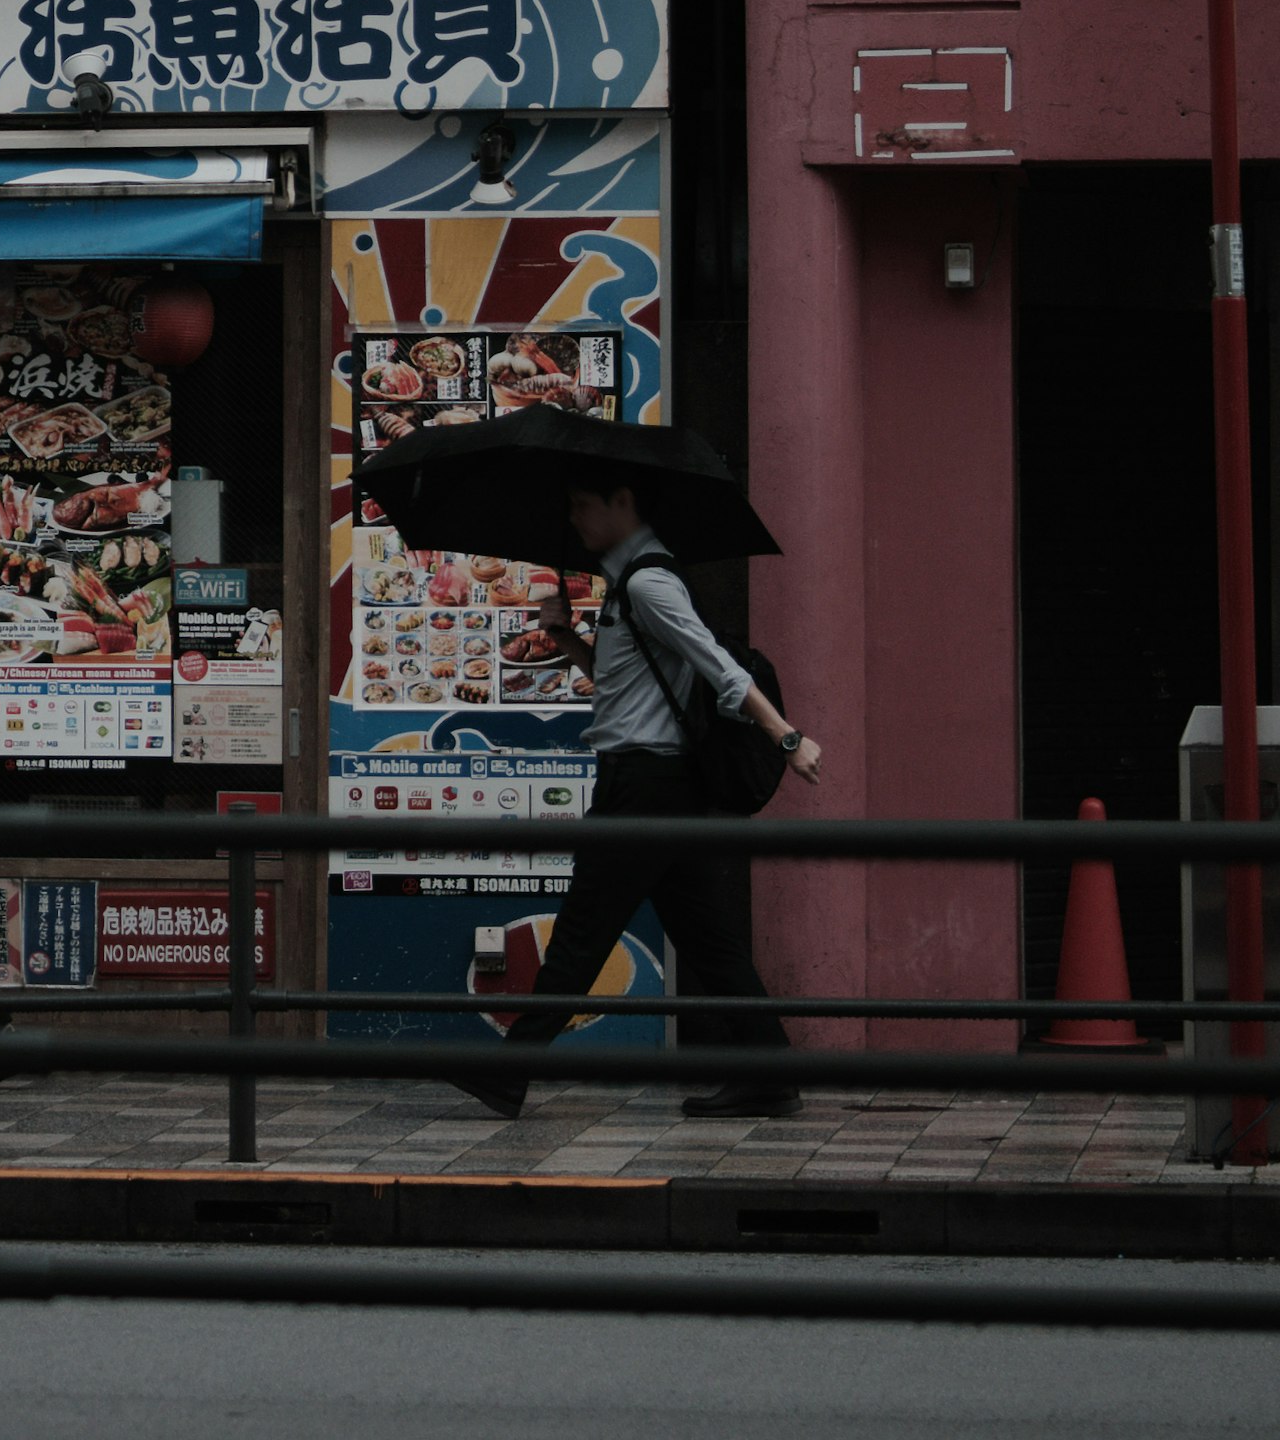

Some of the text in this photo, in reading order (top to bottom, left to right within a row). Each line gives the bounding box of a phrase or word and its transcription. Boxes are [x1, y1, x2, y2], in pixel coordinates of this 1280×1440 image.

[8, 353, 105, 399] 浜焼
[200, 581, 240, 598] WiFi
[178, 612, 245, 624] Mobile Order
[86, 669, 111, 678] menu
[114, 667, 155, 678] available
[49, 760, 89, 769] ISOMARU
[92, 760, 125, 769] SUISAN
[369, 760, 582, 775] Mobile order Cashless
[441, 801, 457, 811] Pay
[420, 878, 572, 893] 磯丸水産 ISOMARU SUI
[104, 944, 264, 963] NO DANGEROUS GOS
